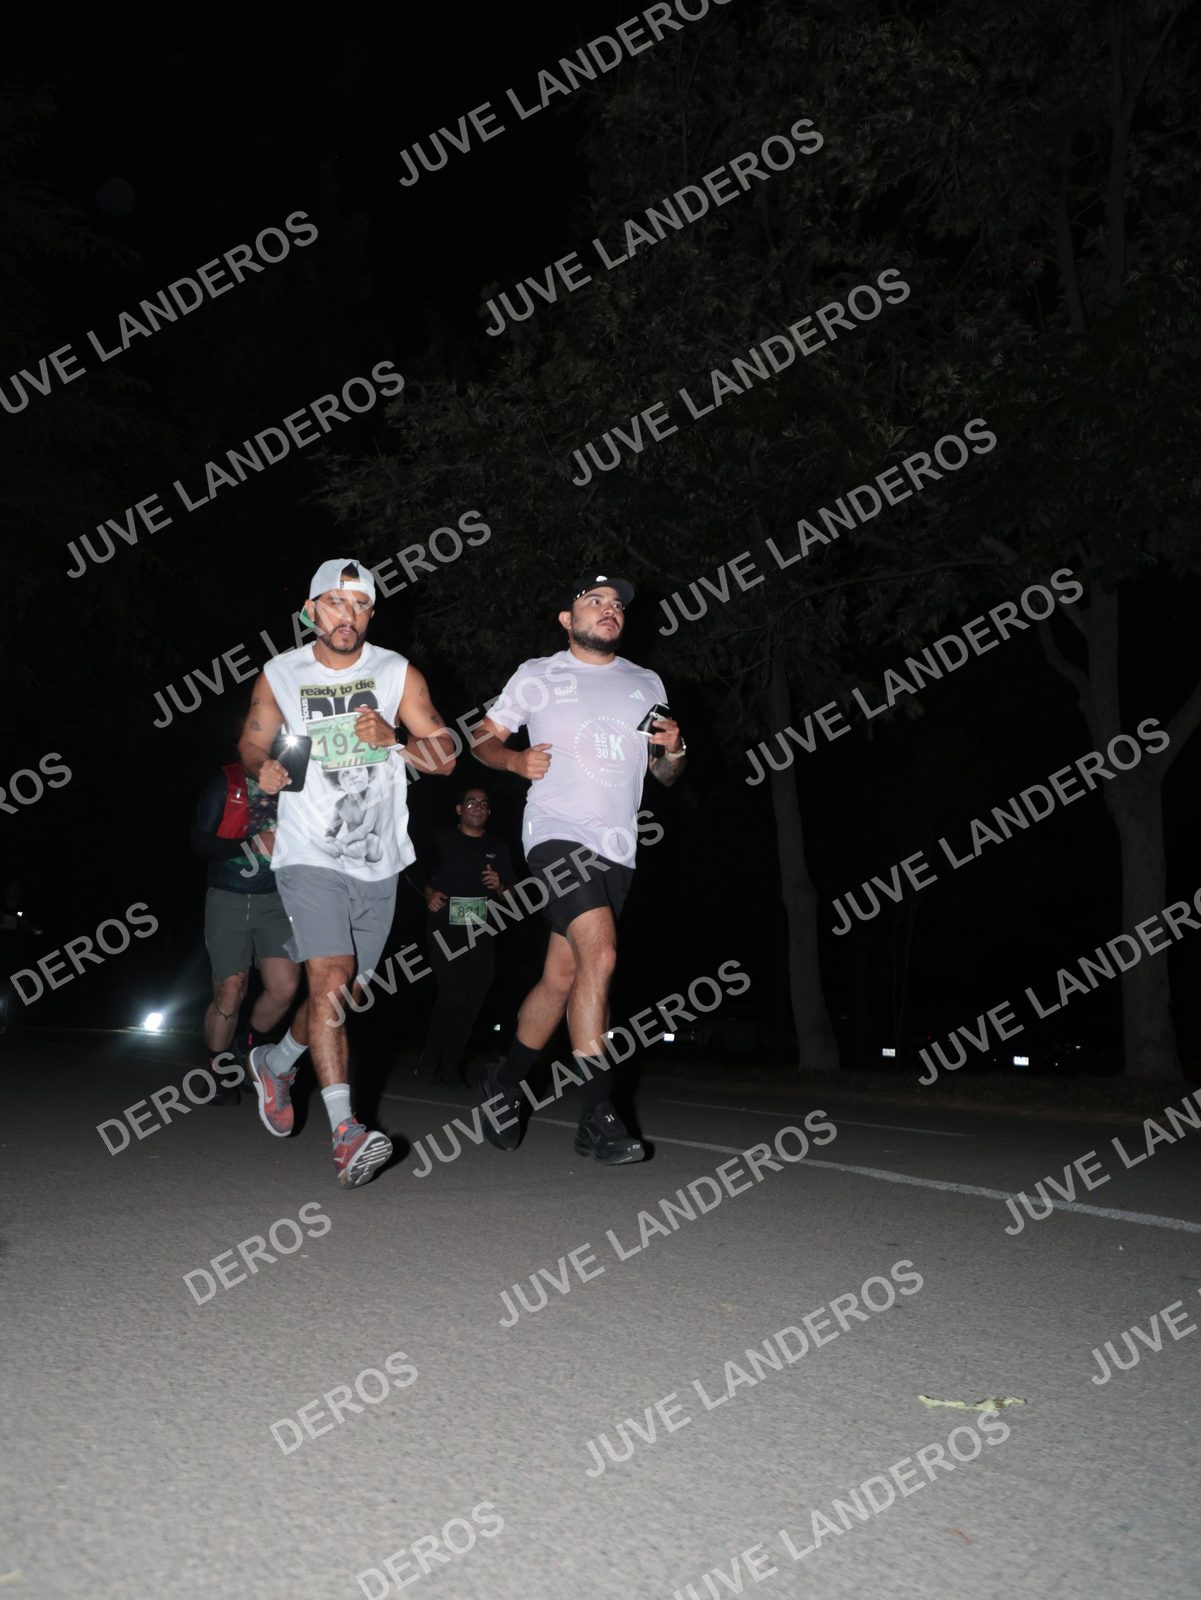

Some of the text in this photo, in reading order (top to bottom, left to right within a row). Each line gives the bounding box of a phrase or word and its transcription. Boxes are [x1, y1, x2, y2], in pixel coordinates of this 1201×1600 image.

[300, 679, 375, 697] ready to die
